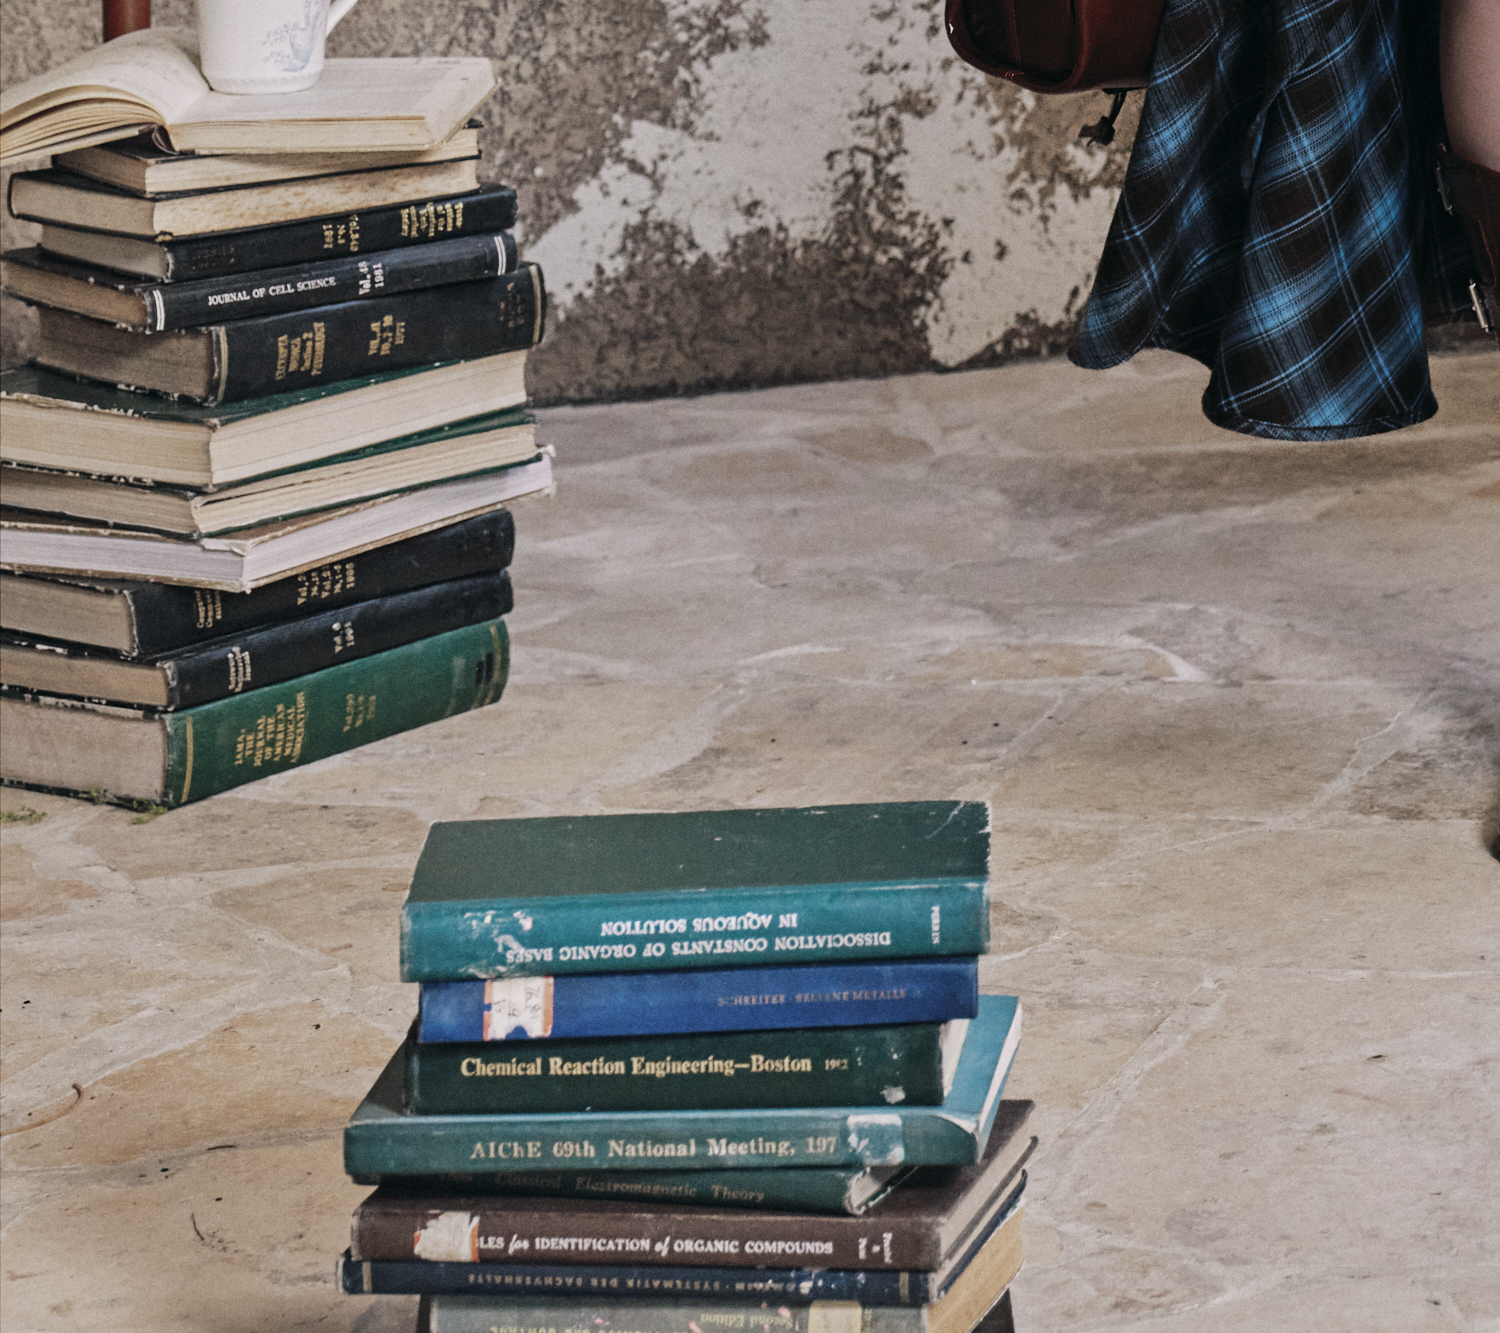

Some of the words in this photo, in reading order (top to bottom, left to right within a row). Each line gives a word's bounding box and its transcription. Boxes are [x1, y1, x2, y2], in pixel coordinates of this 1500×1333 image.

[373, 262, 385, 288] 1981
[208, 290, 250, 306] JOURNAL
[252, 287, 266, 298] OF
[268, 283, 295, 296] CELL
[296, 276, 337, 291] SCIENCE
[266, 717, 275, 741] THE
[273, 703, 285, 762] AMERICAN
[283, 705, 295, 757] MEDICAL
[290, 691, 305, 764] ASSOCIATION
[245, 731, 255, 758] THE
[253, 715, 266, 767] JOURNAL
[264, 746, 273, 761] OF
[600, 916, 687, 937] SOLUTION
[692, 911, 773, 933] AQUEOUS
[779, 912, 798, 929] IN
[930, 904, 941, 945] PERRIN
[642, 942, 666, 958] OF
[671, 937, 768, 956] CONSTANTS
[774, 932, 892, 951] DISSOCIATION
[505, 948, 553, 964] BASES
[559, 944, 637, 961] ORGANIC
[718, 994, 786, 1007] SHREITER
[852, 989, 907, 1001] METALLE
[460, 1056, 542, 1077] Chemical
[548, 1056, 625, 1076] Reaction
[470, 1140, 542, 1161] AIChE
[552, 1139, 595, 1160] 69th
[607, 1138, 696, 1159] National
[706, 1136, 795, 1160] Meeting,
[805, 1136, 838, 1155] 197
[575, 1177, 698, 1198] Electromagnetic
[711, 1184, 765, 1203] Theory
[508, 1233, 530, 1256] for
[535, 1237, 651, 1254] IDENTIFICATION
[654, 1235, 669, 1257] of
[673, 1238, 739, 1254] ORGANIC
[744, 1238, 834, 1255] COMPOUNDS
[590, 1277, 618, 1288] DER
[699, 1313, 745, 1327] Edition
[750, 1314, 793, 1329] Second
